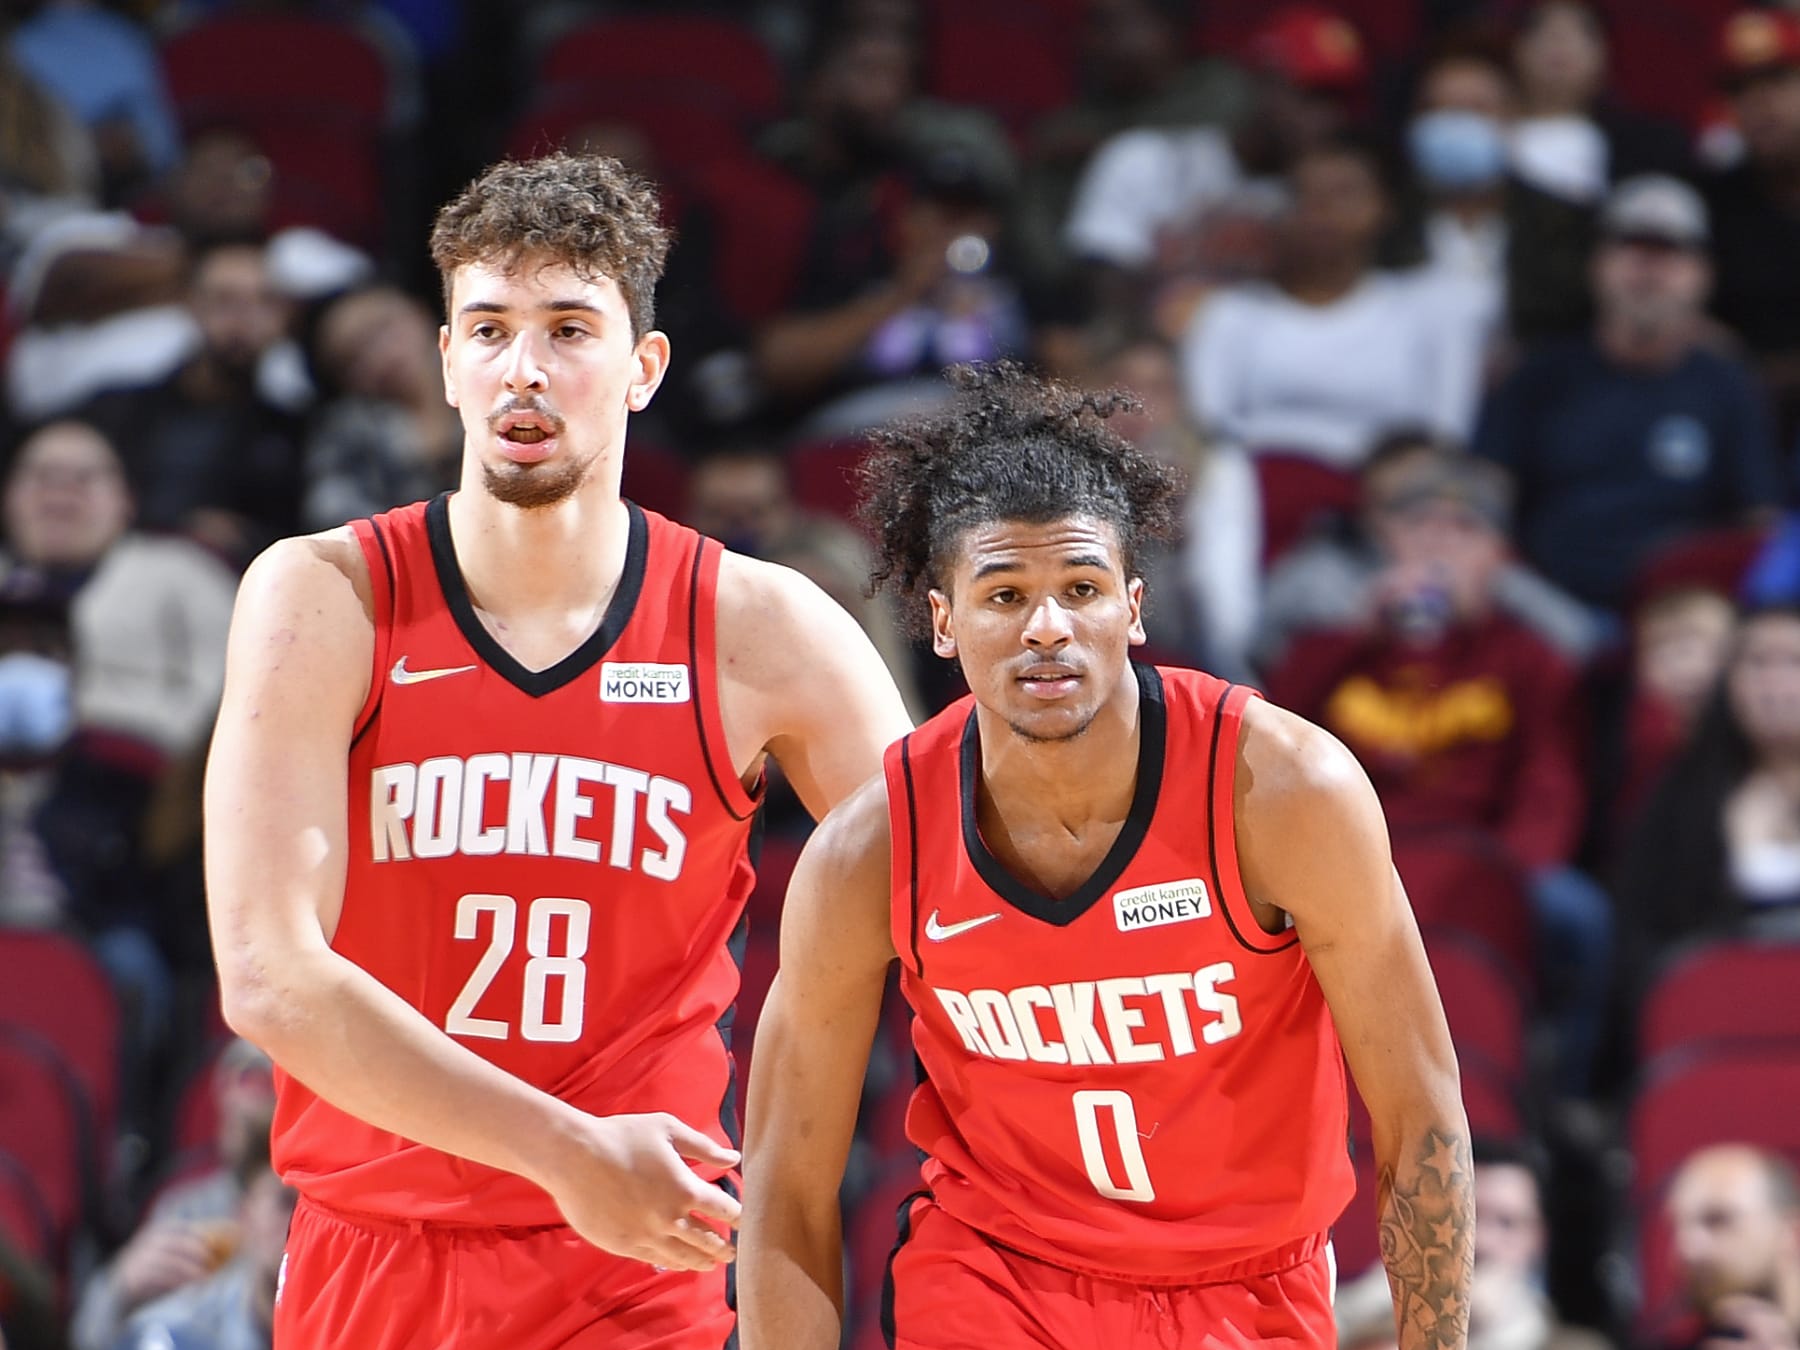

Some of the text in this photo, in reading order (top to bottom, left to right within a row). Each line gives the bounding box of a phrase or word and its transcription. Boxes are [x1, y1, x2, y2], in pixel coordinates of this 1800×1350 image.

[606, 681, 681, 698] MONEY
[642, 667, 682, 679] karma
[370, 753, 691, 881] ROCKETS
[1120, 886, 1202, 908] credit karma
[1122, 897, 1202, 926] MONEY
[445, 893, 591, 1042] 28
[932, 961, 1242, 1066] ROCKETS
[1072, 1090, 1155, 1202] 0
